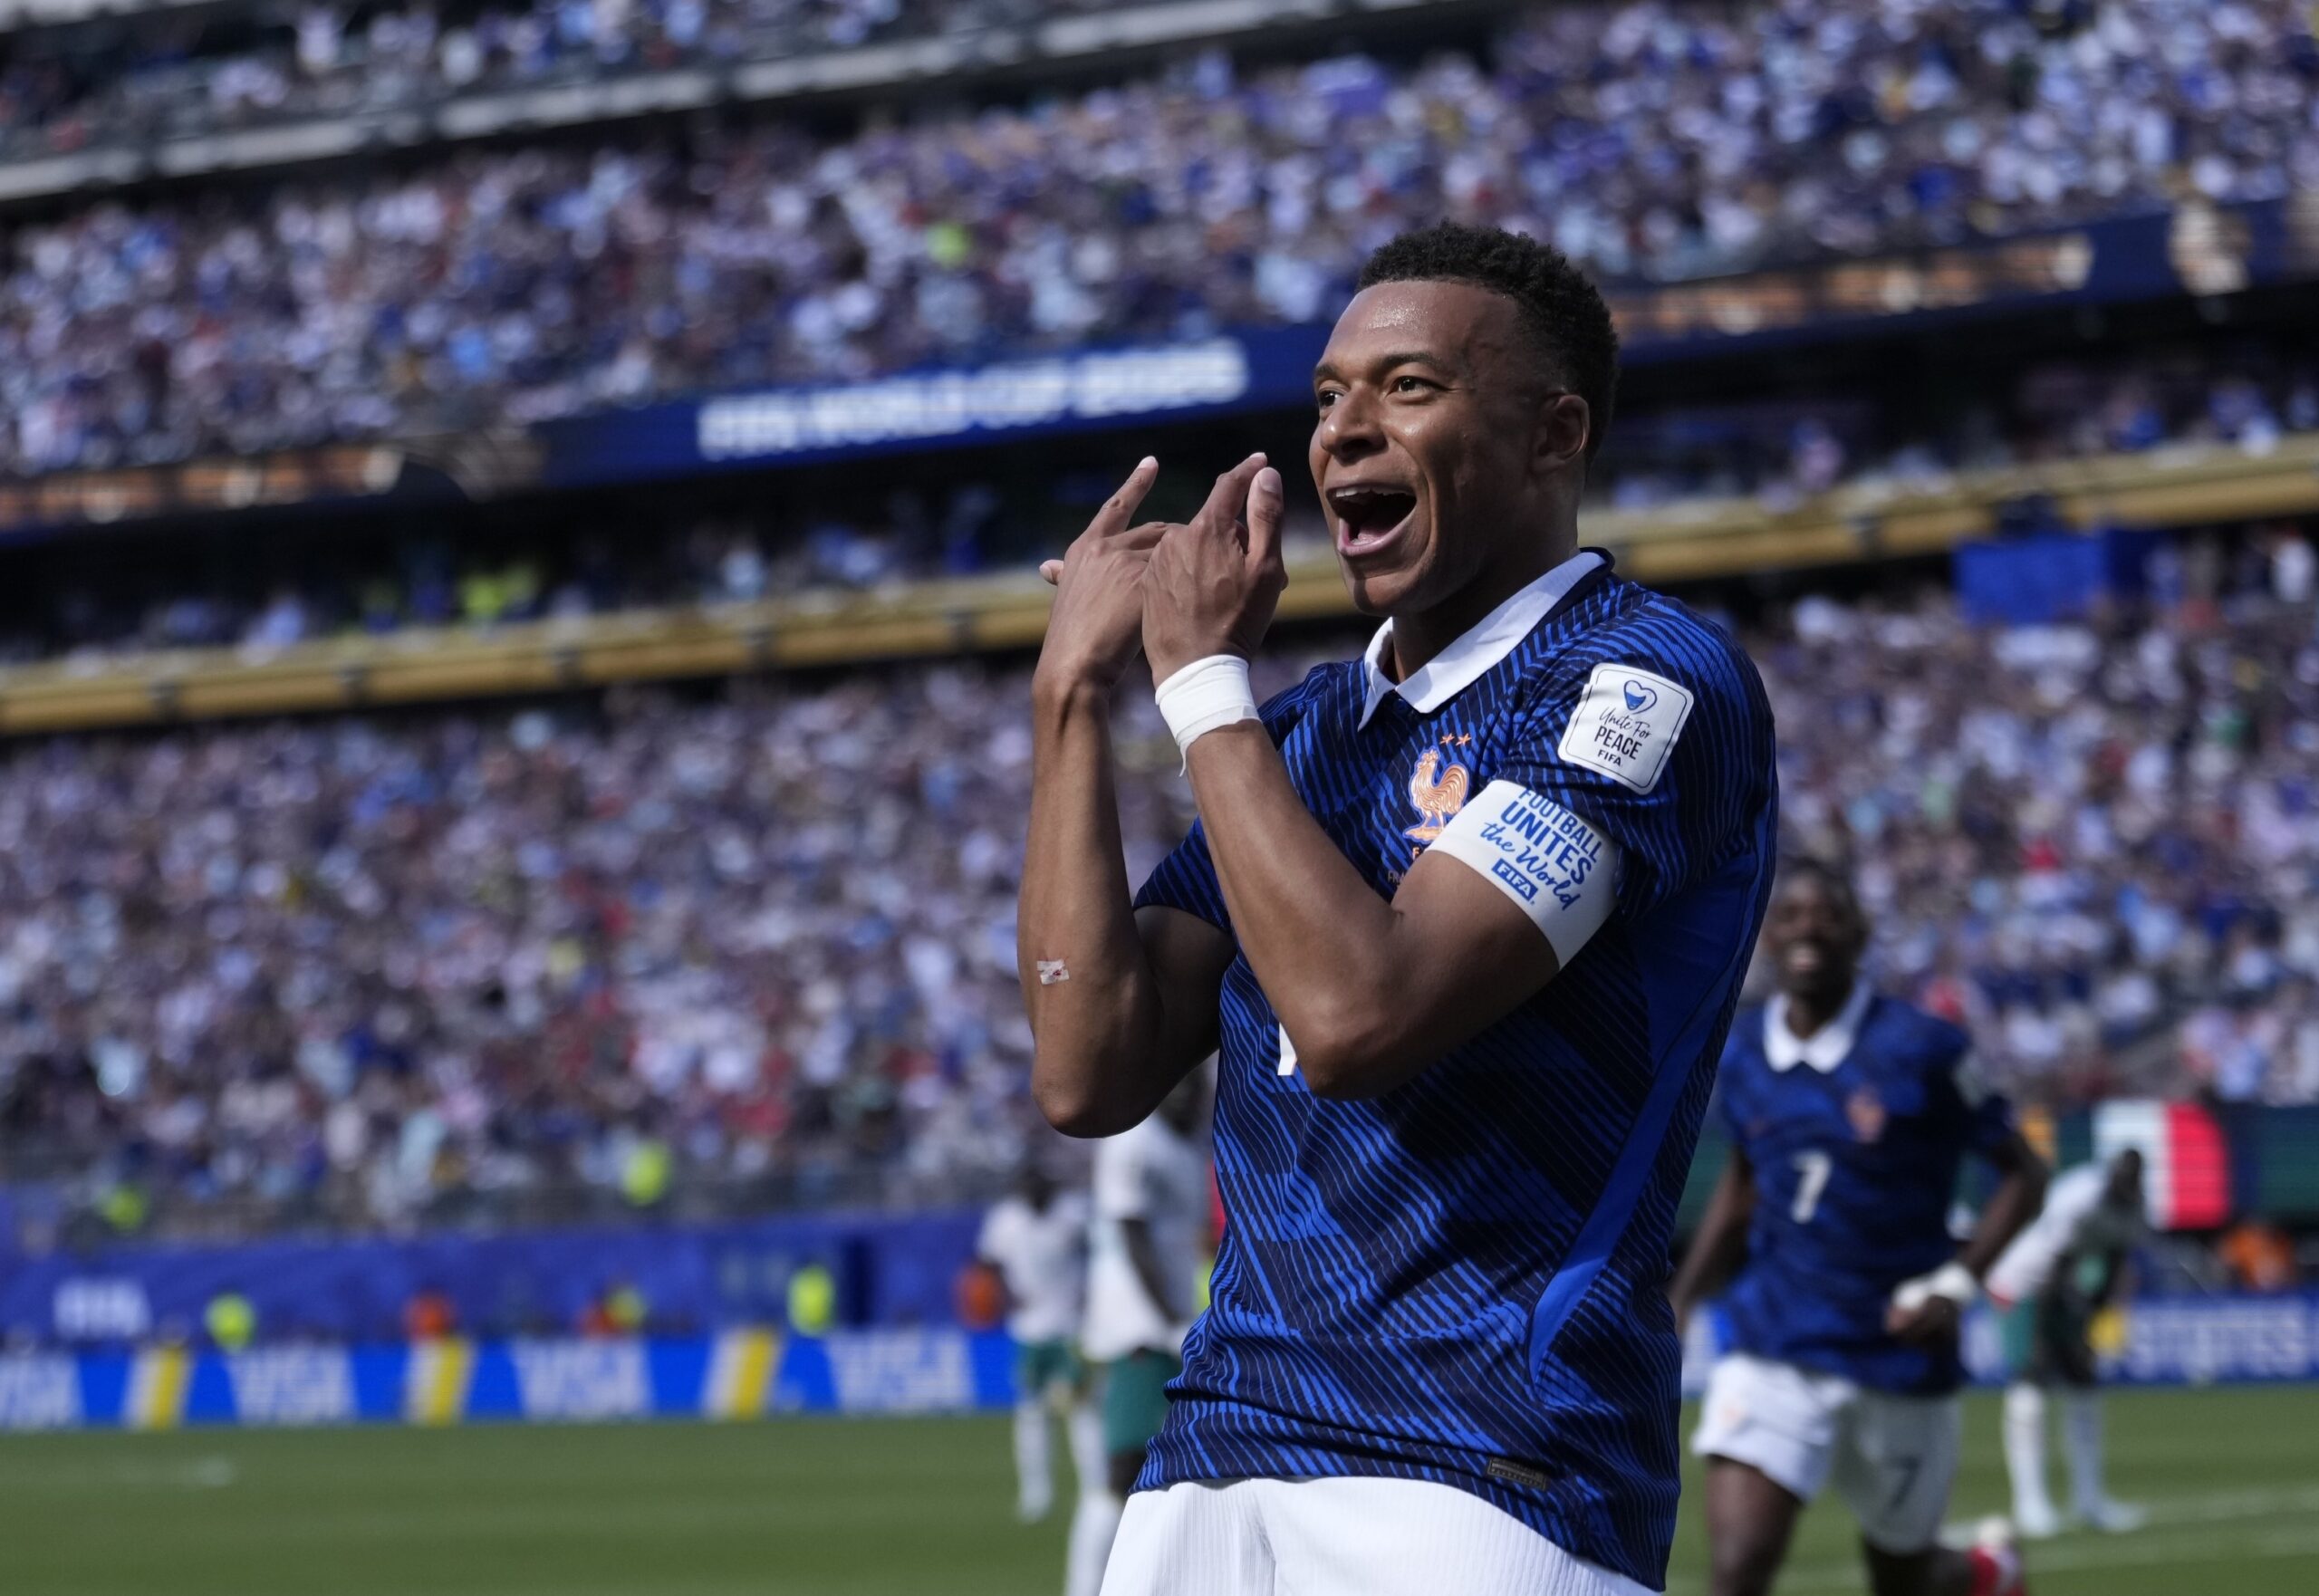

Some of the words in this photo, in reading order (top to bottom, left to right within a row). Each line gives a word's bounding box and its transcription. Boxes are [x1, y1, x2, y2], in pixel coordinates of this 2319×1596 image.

[1594, 726, 1642, 760] PEACE
[1599, 707, 1633, 730] Unite
[1632, 720, 1651, 739] For
[1597, 749, 1621, 767] FIFA
[1500, 800, 1592, 885] UNITES
[1518, 787, 1602, 863] FOOTBALL
[1480, 822, 1516, 852] the
[1516, 845, 1581, 911] World
[1495, 861, 1535, 899] FIFA
[1790, 1149, 1832, 1223] 7
